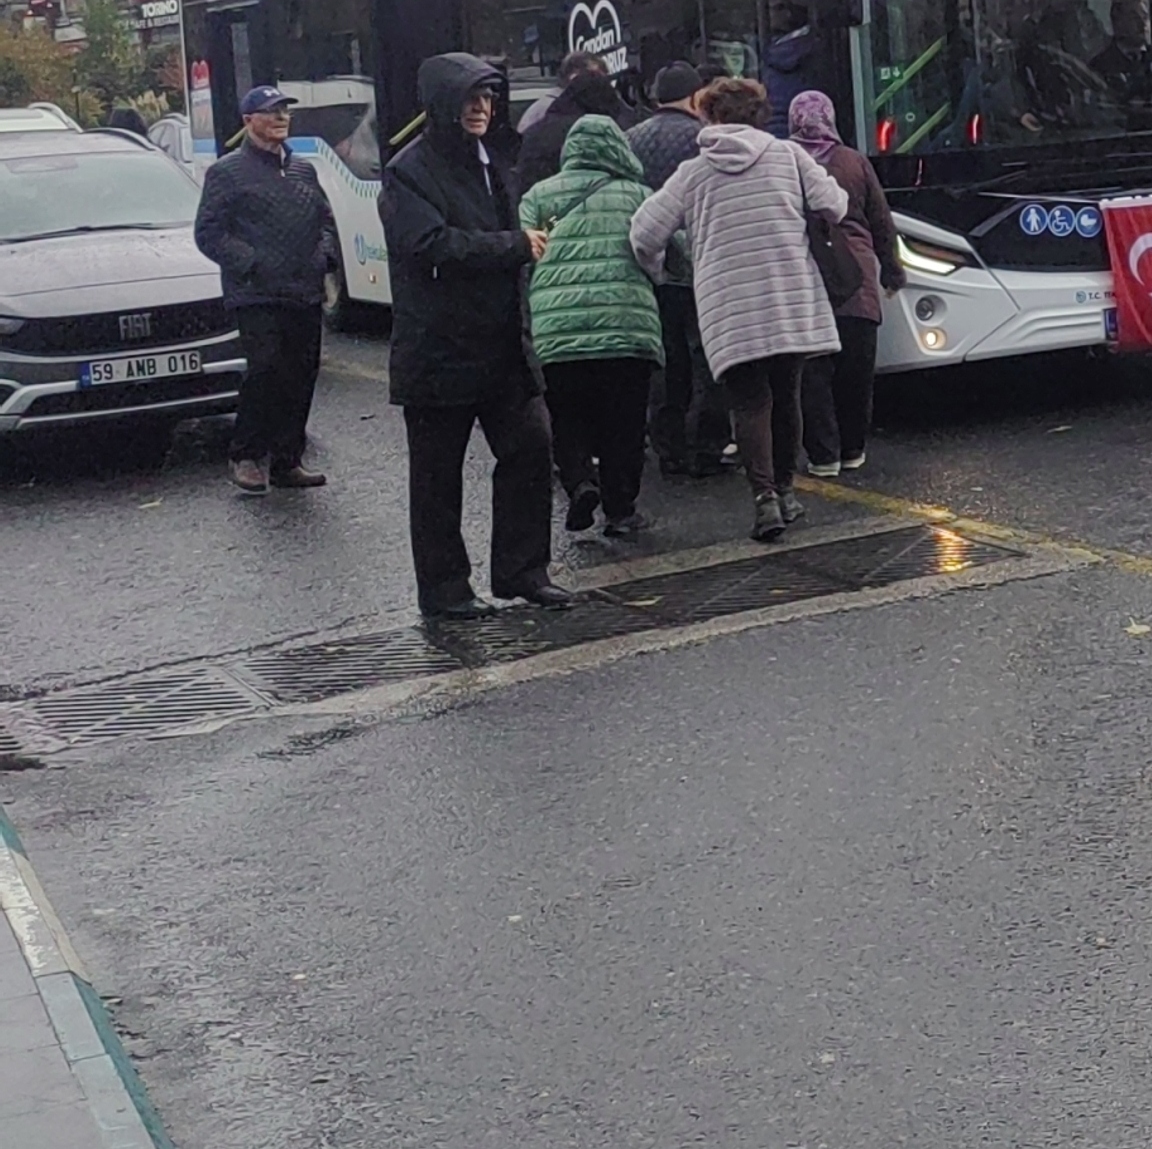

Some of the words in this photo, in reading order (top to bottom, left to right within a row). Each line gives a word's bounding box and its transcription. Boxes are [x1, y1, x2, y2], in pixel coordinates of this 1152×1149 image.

[119, 313, 152, 341] FIAT
[92, 363, 113, 382] 59
[168, 353, 199, 373] 016
